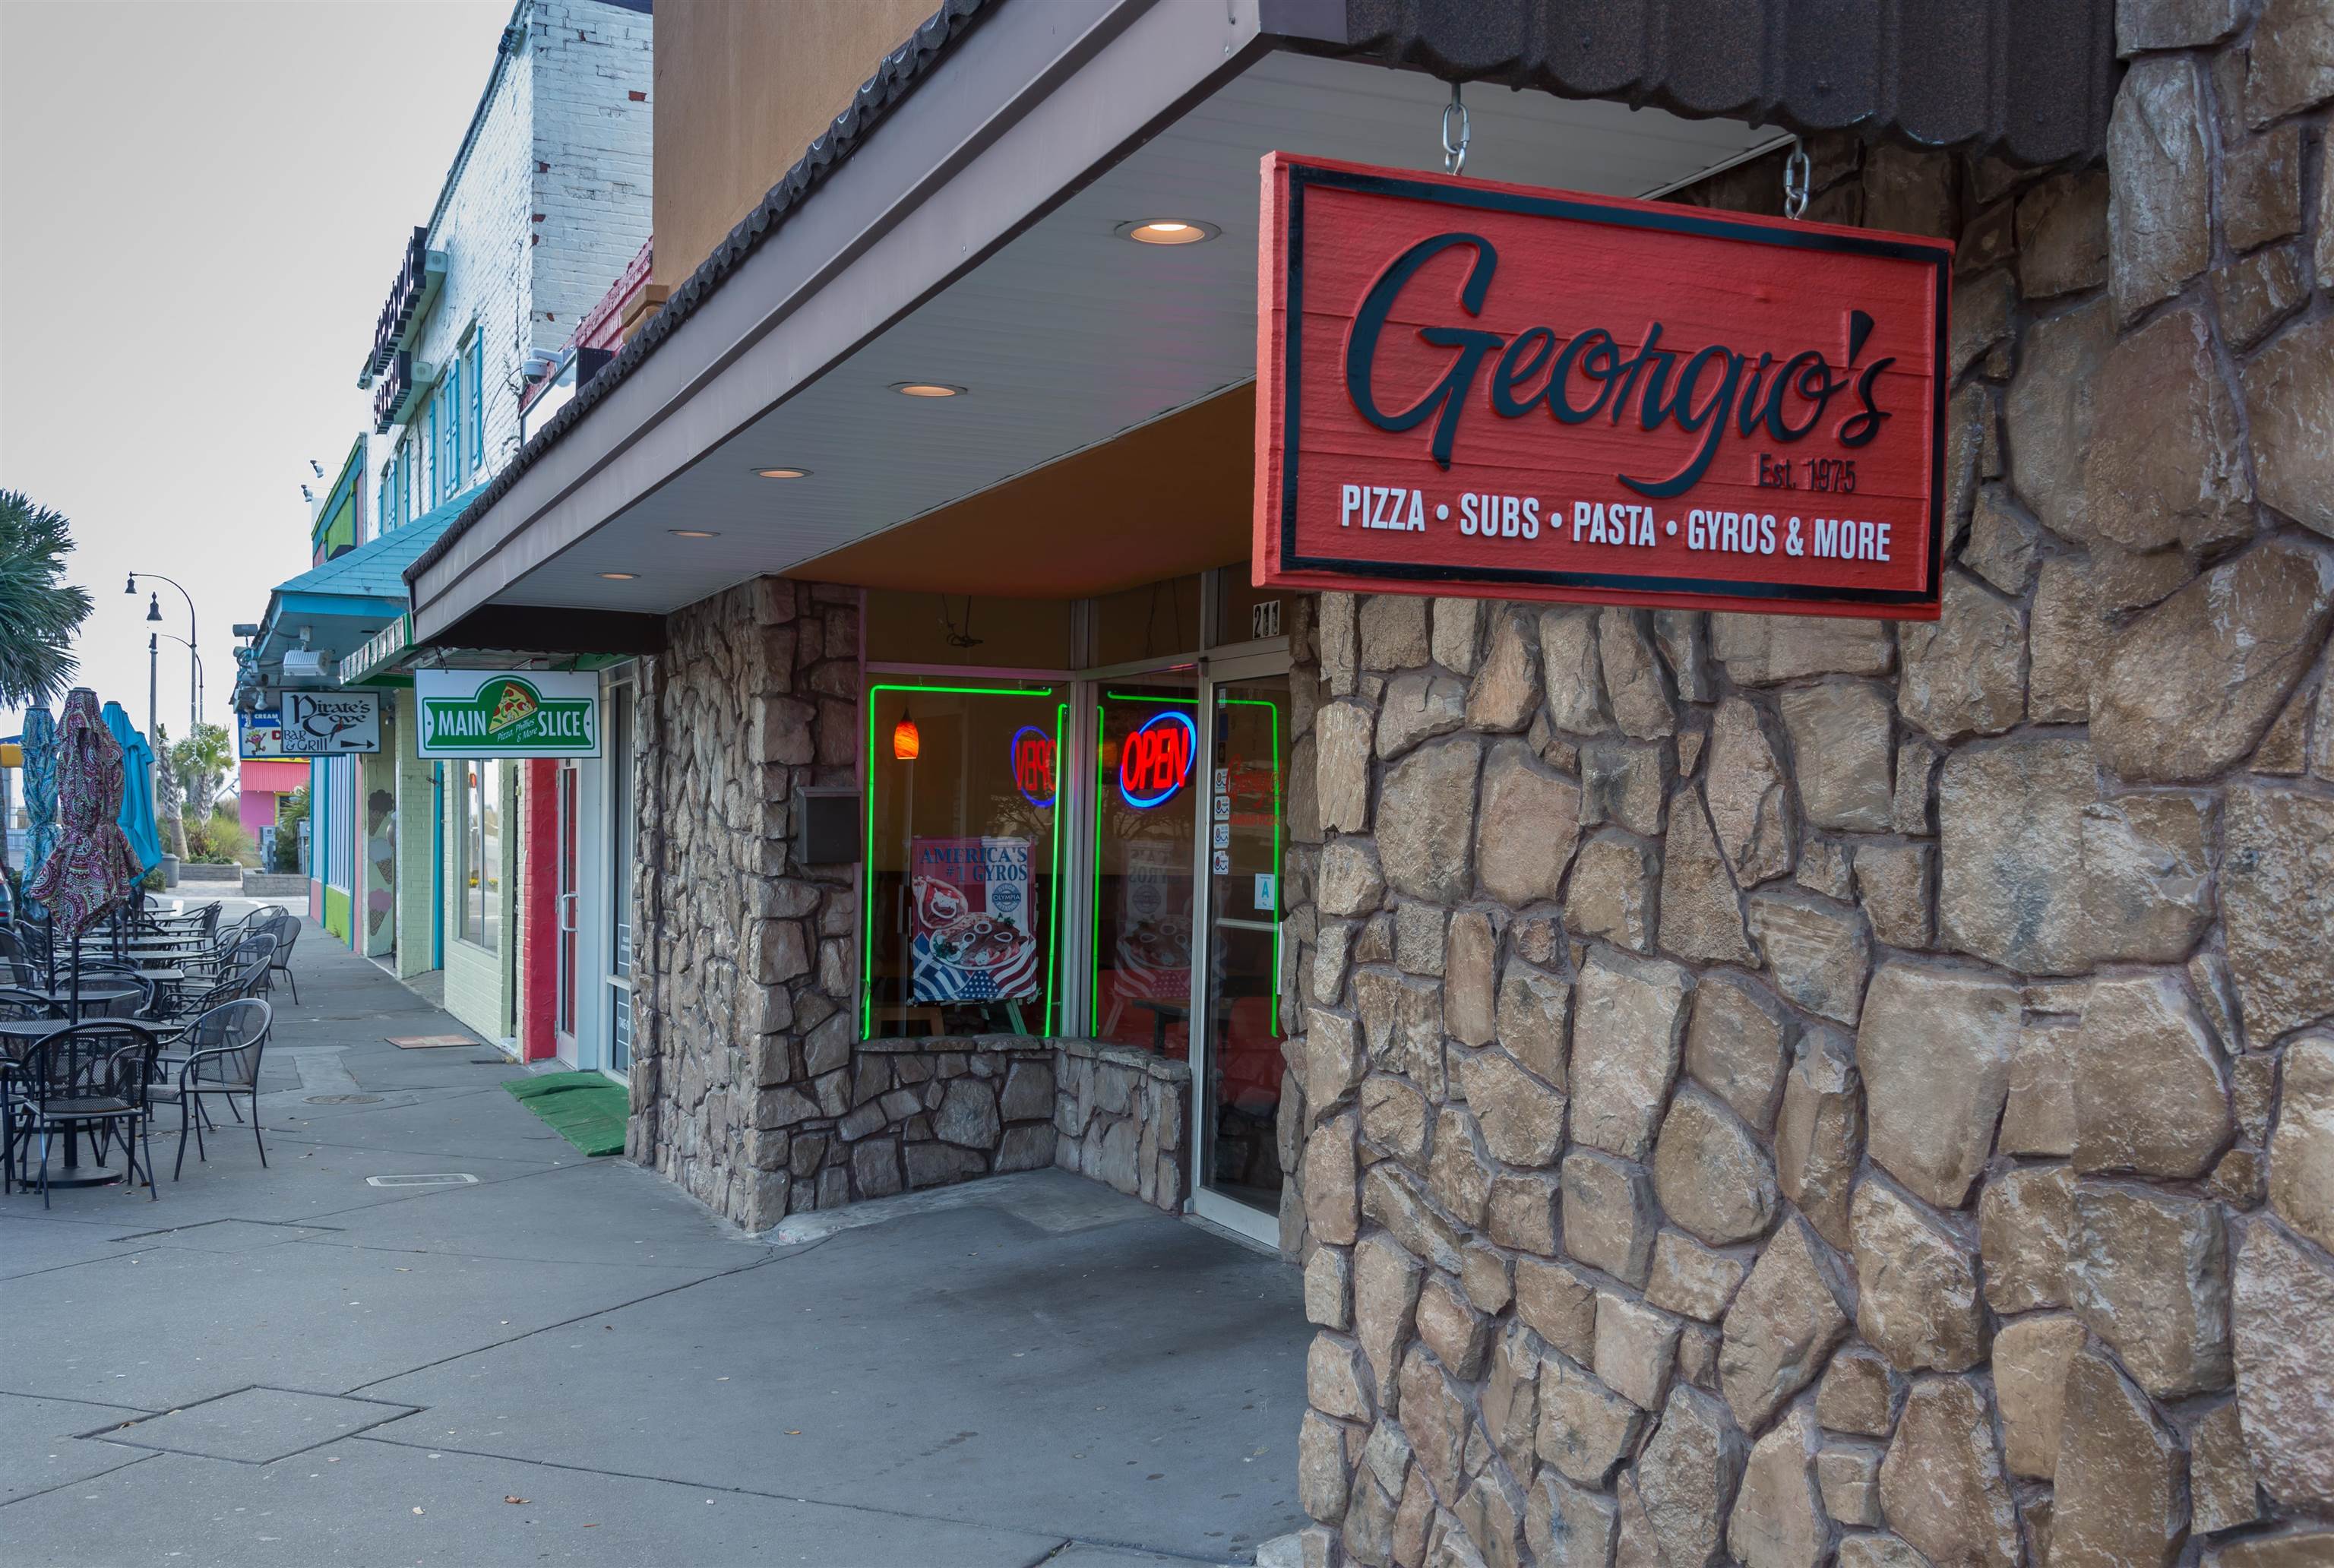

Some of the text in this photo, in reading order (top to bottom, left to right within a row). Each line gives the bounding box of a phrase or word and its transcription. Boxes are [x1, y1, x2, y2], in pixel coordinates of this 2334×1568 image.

[1346, 232, 1896, 498] Georgio's
[1760, 454, 1855, 493] Est. 1975
[1342, 485, 1891, 561] PIZZA SUBS PASTA GYROS & MORE
[1254, 601, 1278, 638] 211
[290, 694, 371, 724] Pirate's
[438, 710, 580, 736] MAIN SLICE
[302, 713, 366, 737] Cove
[1122, 726, 1188, 791] OPEN
[920, 847, 1027, 864] AMERICA'S
[947, 865, 1027, 882] #1 GYROS
[1262, 880, 1269, 898] A
